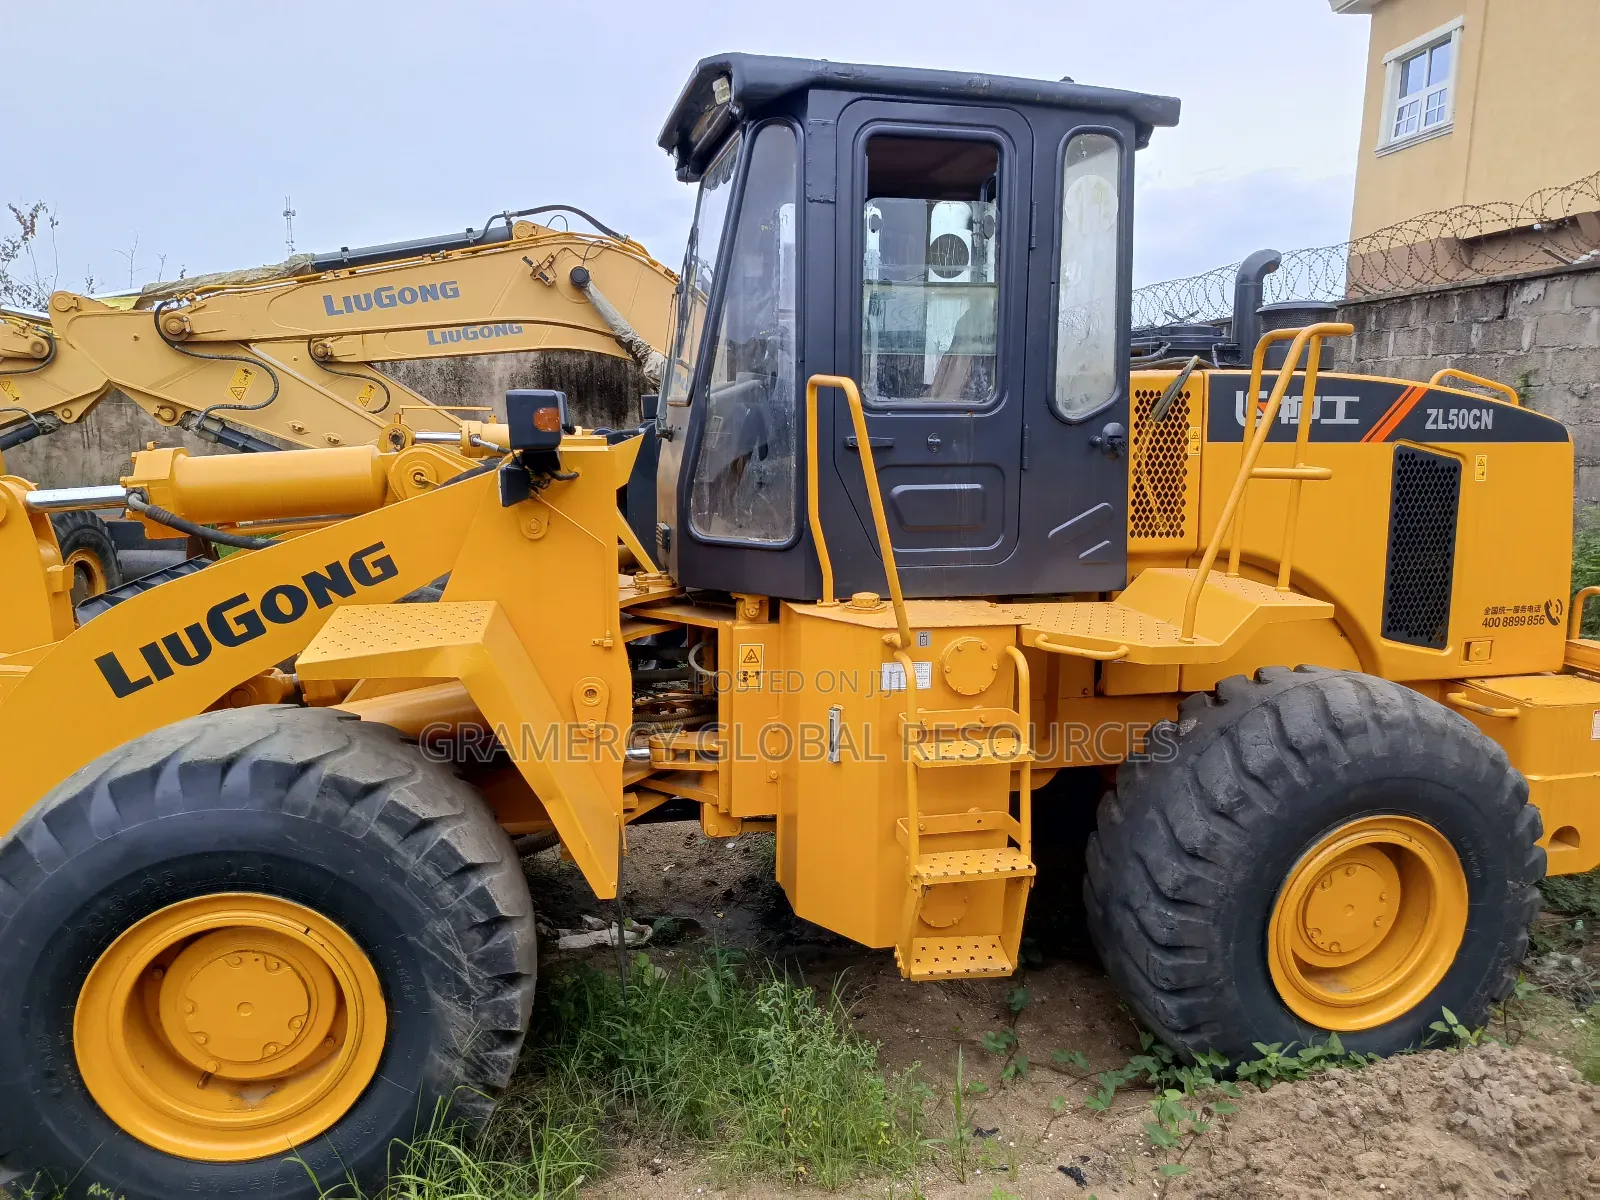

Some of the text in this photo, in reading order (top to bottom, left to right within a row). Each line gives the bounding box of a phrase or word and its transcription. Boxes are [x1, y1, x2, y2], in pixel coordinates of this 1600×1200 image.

[1425, 408, 1494, 430] ZL50CN
[1484, 604, 1542, 615] 全国统一服务电话
[1481, 614, 1546, 628] 400 8899 856
